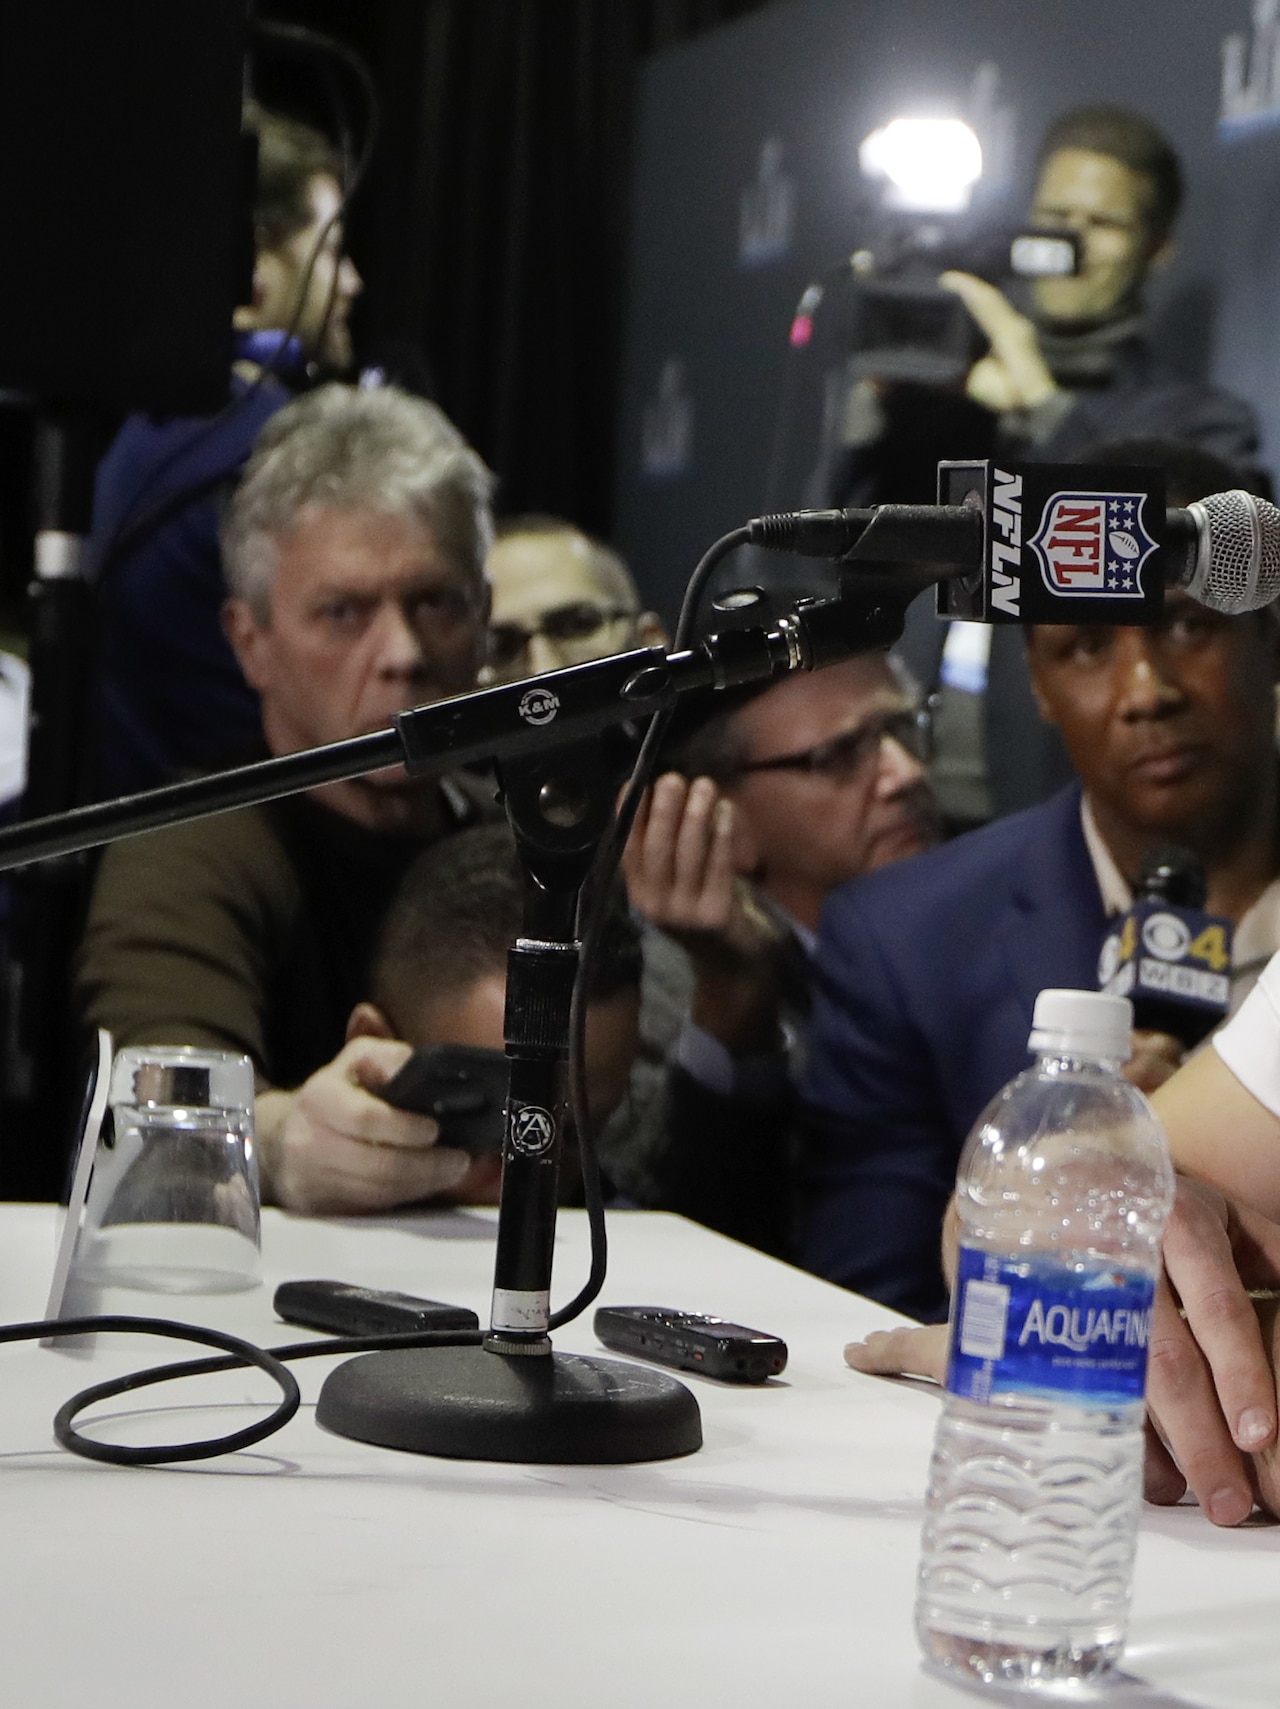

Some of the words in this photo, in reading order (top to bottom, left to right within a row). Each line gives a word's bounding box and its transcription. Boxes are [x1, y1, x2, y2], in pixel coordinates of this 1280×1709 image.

[991, 468, 1023, 616] NFLN
[1047, 505, 1101, 584] NFL
[518, 697, 561, 717] K&M
